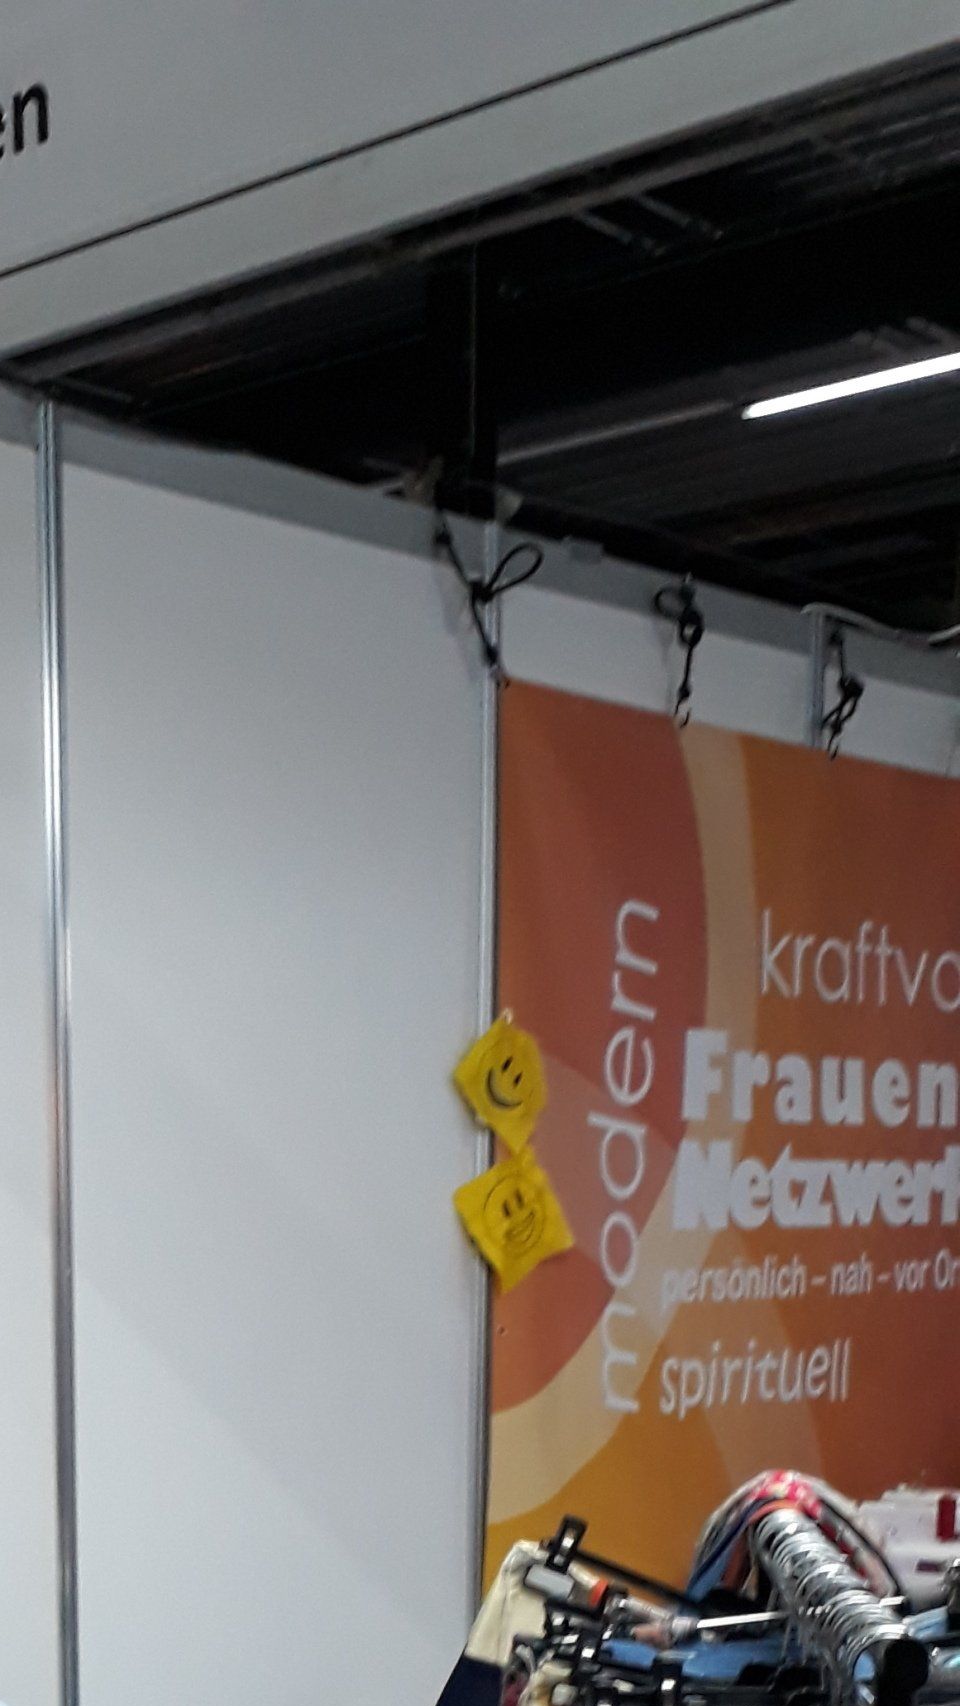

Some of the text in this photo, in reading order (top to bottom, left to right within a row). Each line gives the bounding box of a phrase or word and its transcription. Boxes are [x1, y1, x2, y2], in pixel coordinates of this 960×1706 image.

[680, 1027, 958, 1129] Frauen
[586, 898, 660, 1414] modern
[659, 1251, 807, 1313] persönlich
[829, 1250, 874, 1297] nah
[894, 1258, 932, 1294] vor
[658, 1336, 853, 1421] spirituell
